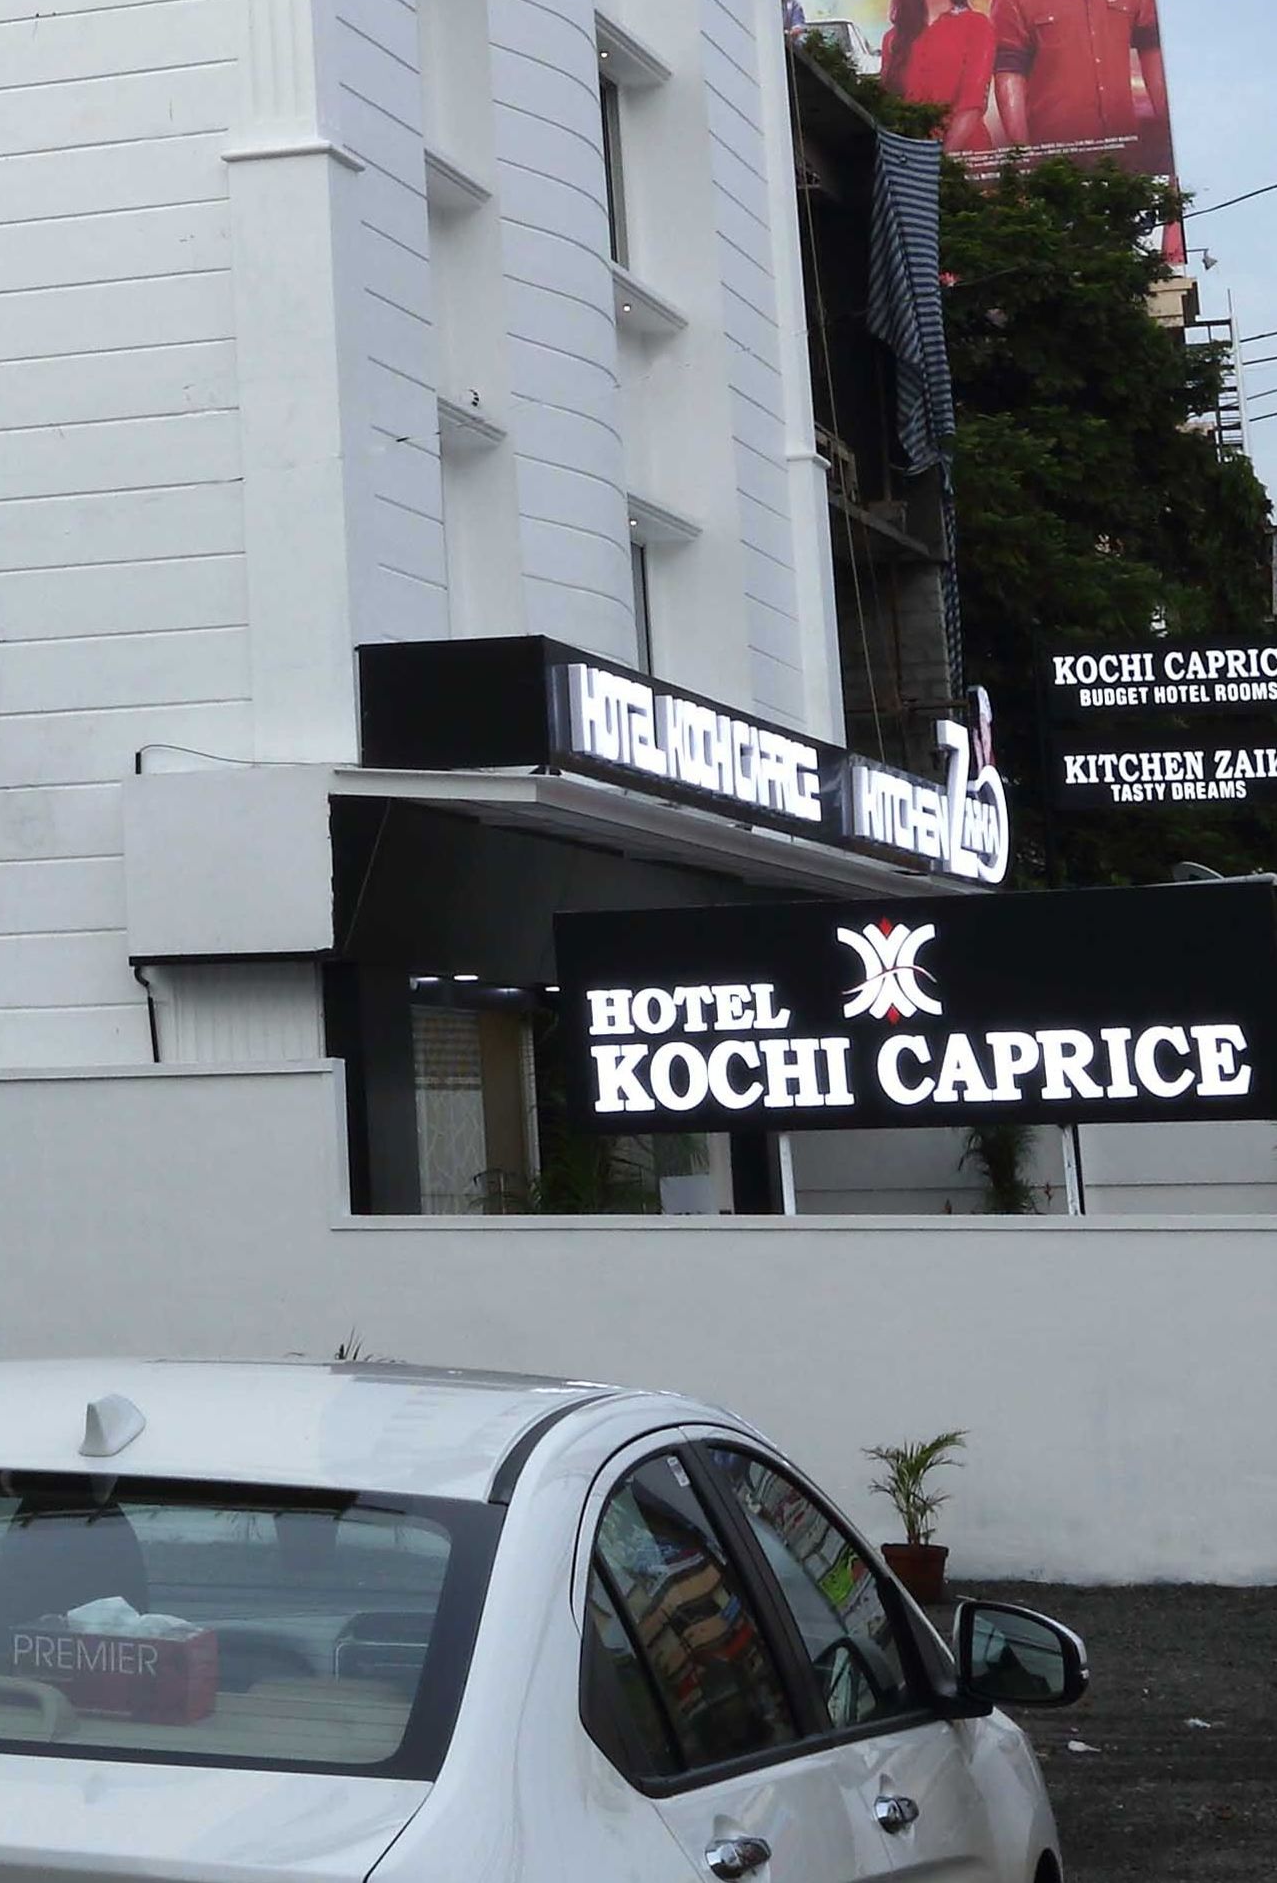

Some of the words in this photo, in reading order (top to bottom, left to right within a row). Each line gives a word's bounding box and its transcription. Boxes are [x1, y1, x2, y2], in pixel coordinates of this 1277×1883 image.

[1052, 653, 1156, 685] KOCHI
[1079, 686, 1149, 706] BUDGET
[1153, 685, 1210, 704] HOTEL
[1214, 681, 1277, 702] ROOMS
[568, 663, 668, 777] HOTEL
[655, 695, 734, 795] KOCHI
[731, 720, 822, 822] CAPRICE
[1063, 751, 1204, 784] KITCHEN
[1110, 783, 1166, 802] TASTY
[1171, 780, 1247, 800] DREAMS
[852, 766, 951, 861] KITCHEN
[586, 983, 791, 1035] HOTEL
[590, 1037, 855, 1114] KOCHI
[877, 1024, 1253, 1103] CAPRICE
[13, 1633, 159, 1676] PREMIER
